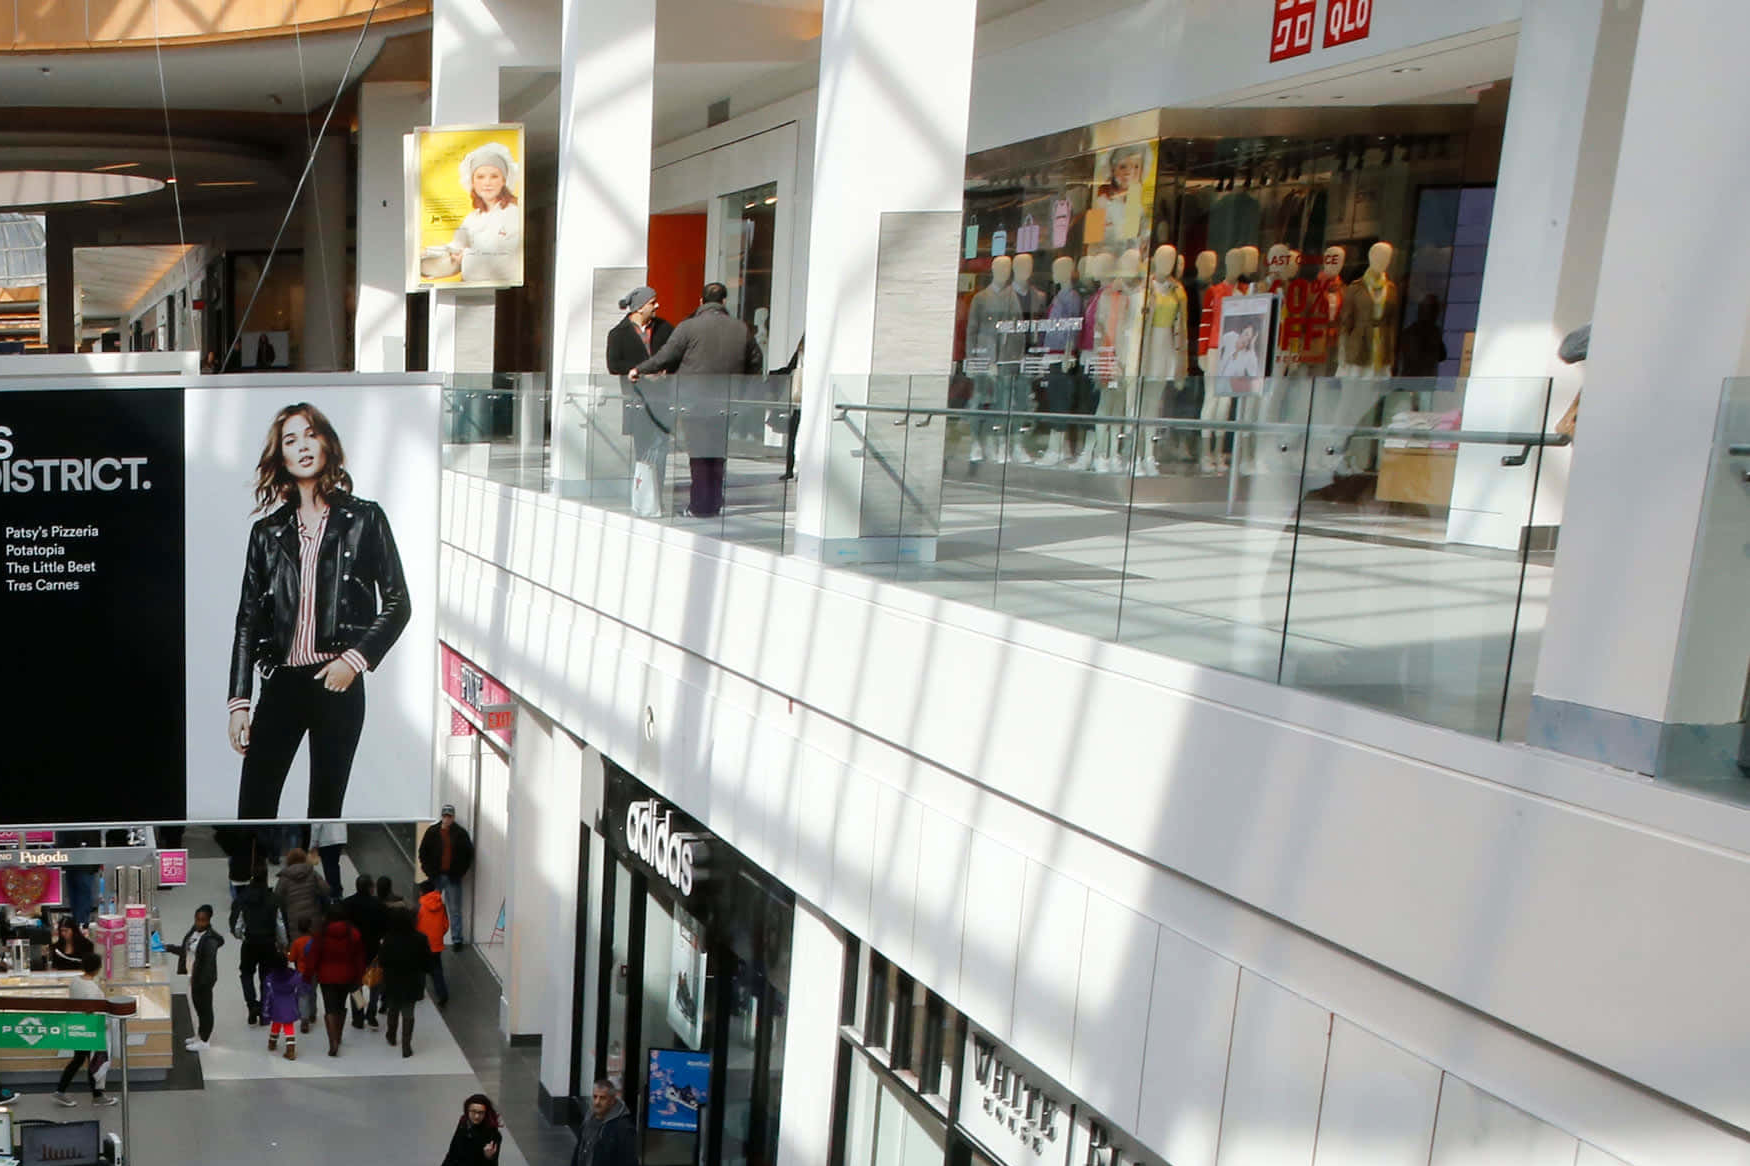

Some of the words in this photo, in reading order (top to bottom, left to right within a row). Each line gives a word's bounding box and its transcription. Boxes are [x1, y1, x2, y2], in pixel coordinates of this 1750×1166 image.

[1278, 318, 1330, 351] FF
[51, 524, 99, 538] Pizzeria
[6, 543, 65, 558] Potatopia
[5, 561, 30, 574] The
[33, 560, 65, 573] Little
[68, 560, 97, 572] Beet
[5, 579, 33, 592] Tres
[35, 578, 80, 591] Carnes
[626, 798, 693, 896] adidas
[19, 850, 69, 866] Pagoda
[2, 1026, 61, 1036] PETRO
